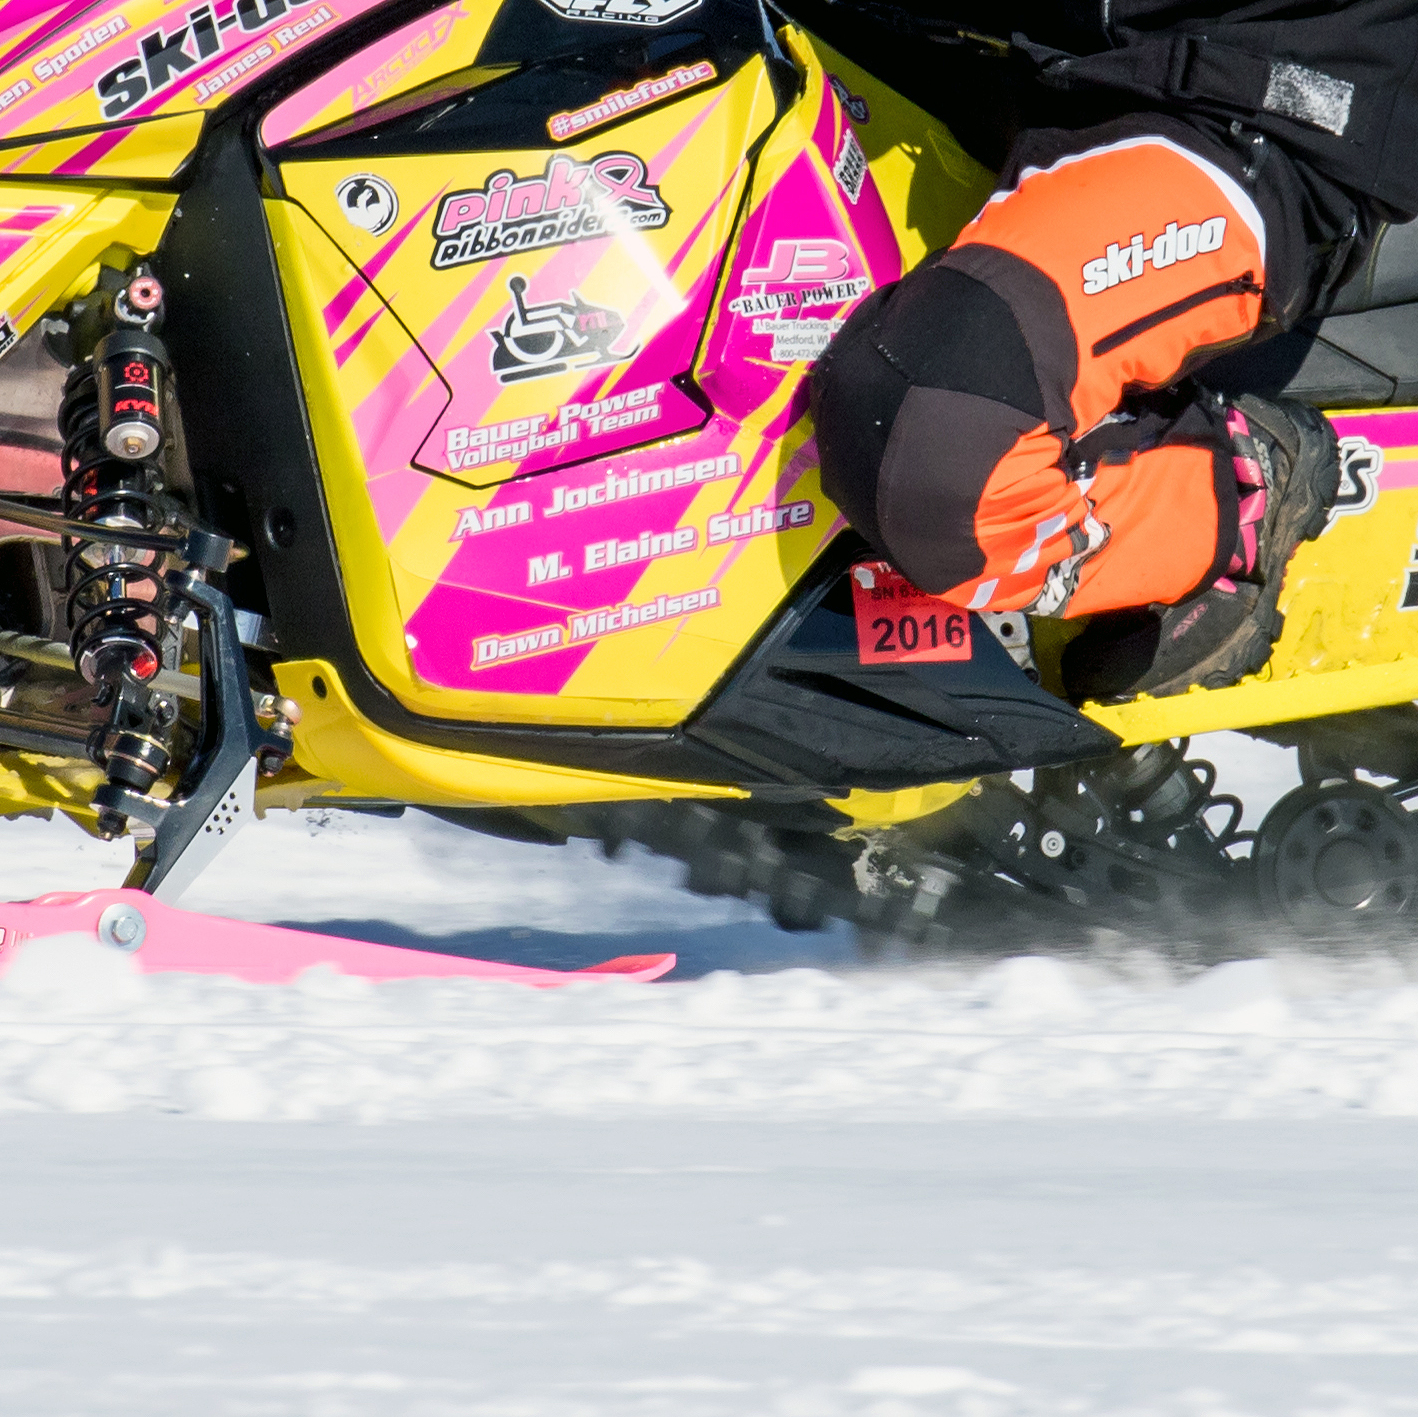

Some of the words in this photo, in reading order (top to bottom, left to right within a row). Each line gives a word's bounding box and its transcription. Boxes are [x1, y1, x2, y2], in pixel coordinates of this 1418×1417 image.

[34, 15, 129, 82] Spoden
[566, 9, 659, 23] RACING
[196, 43, 273, 103] James
[276, 9, 335, 45] Reul
[552, 63, 710, 135] #smileforbc
[442, 161, 589, 232] pink
[440, 207, 661, 263] RibbonRidercom
[1083, 217, 1226, 294] ski-doo
[765, 322, 790, 331] Bauer
[447, 415, 546, 453] Bauer
[559, 383, 663, 426] Power
[448, 423, 578, 471] Volleyball
[589, 405, 660, 437] Team
[453, 501, 531, 539] Ann
[544, 454, 741, 516] Jochimsen
[528, 553, 571, 586] M.
[584, 527, 695, 572] Elaine
[708, 502, 811, 543] Suhre
[476, 627, 561, 665] Dawn
[570, 588, 719, 640] Michelsen
[871, 614, 965, 653] 2016
